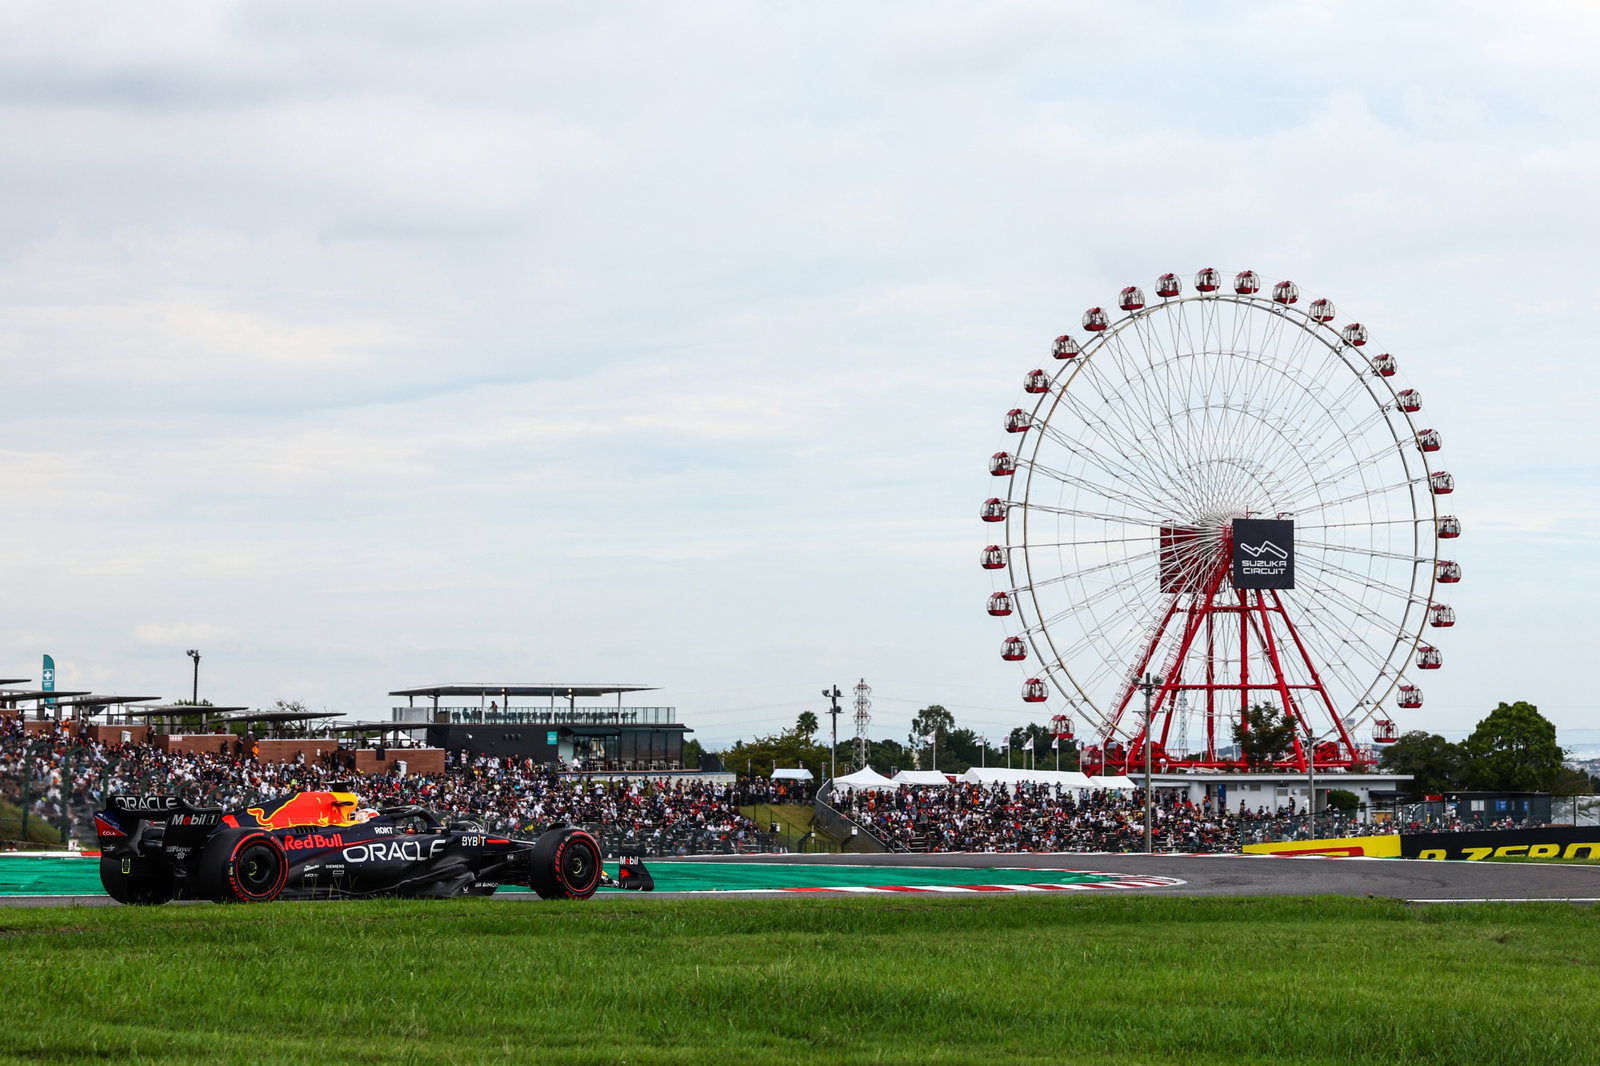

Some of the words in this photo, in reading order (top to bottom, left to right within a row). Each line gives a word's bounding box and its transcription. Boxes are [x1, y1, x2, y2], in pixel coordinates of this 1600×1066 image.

[1242, 567, 1286, 575] CIRCUIT
[115, 796, 181, 812] ORACLE
[171, 814, 207, 826] Mobil
[374, 827, 393, 835] ROKT
[284, 834, 314, 851] Red
[314, 833, 344, 848] Bull
[461, 835, 487, 847] BYBIT
[343, 839, 447, 863] ORACLE
[619, 855, 639, 865] Mobil
